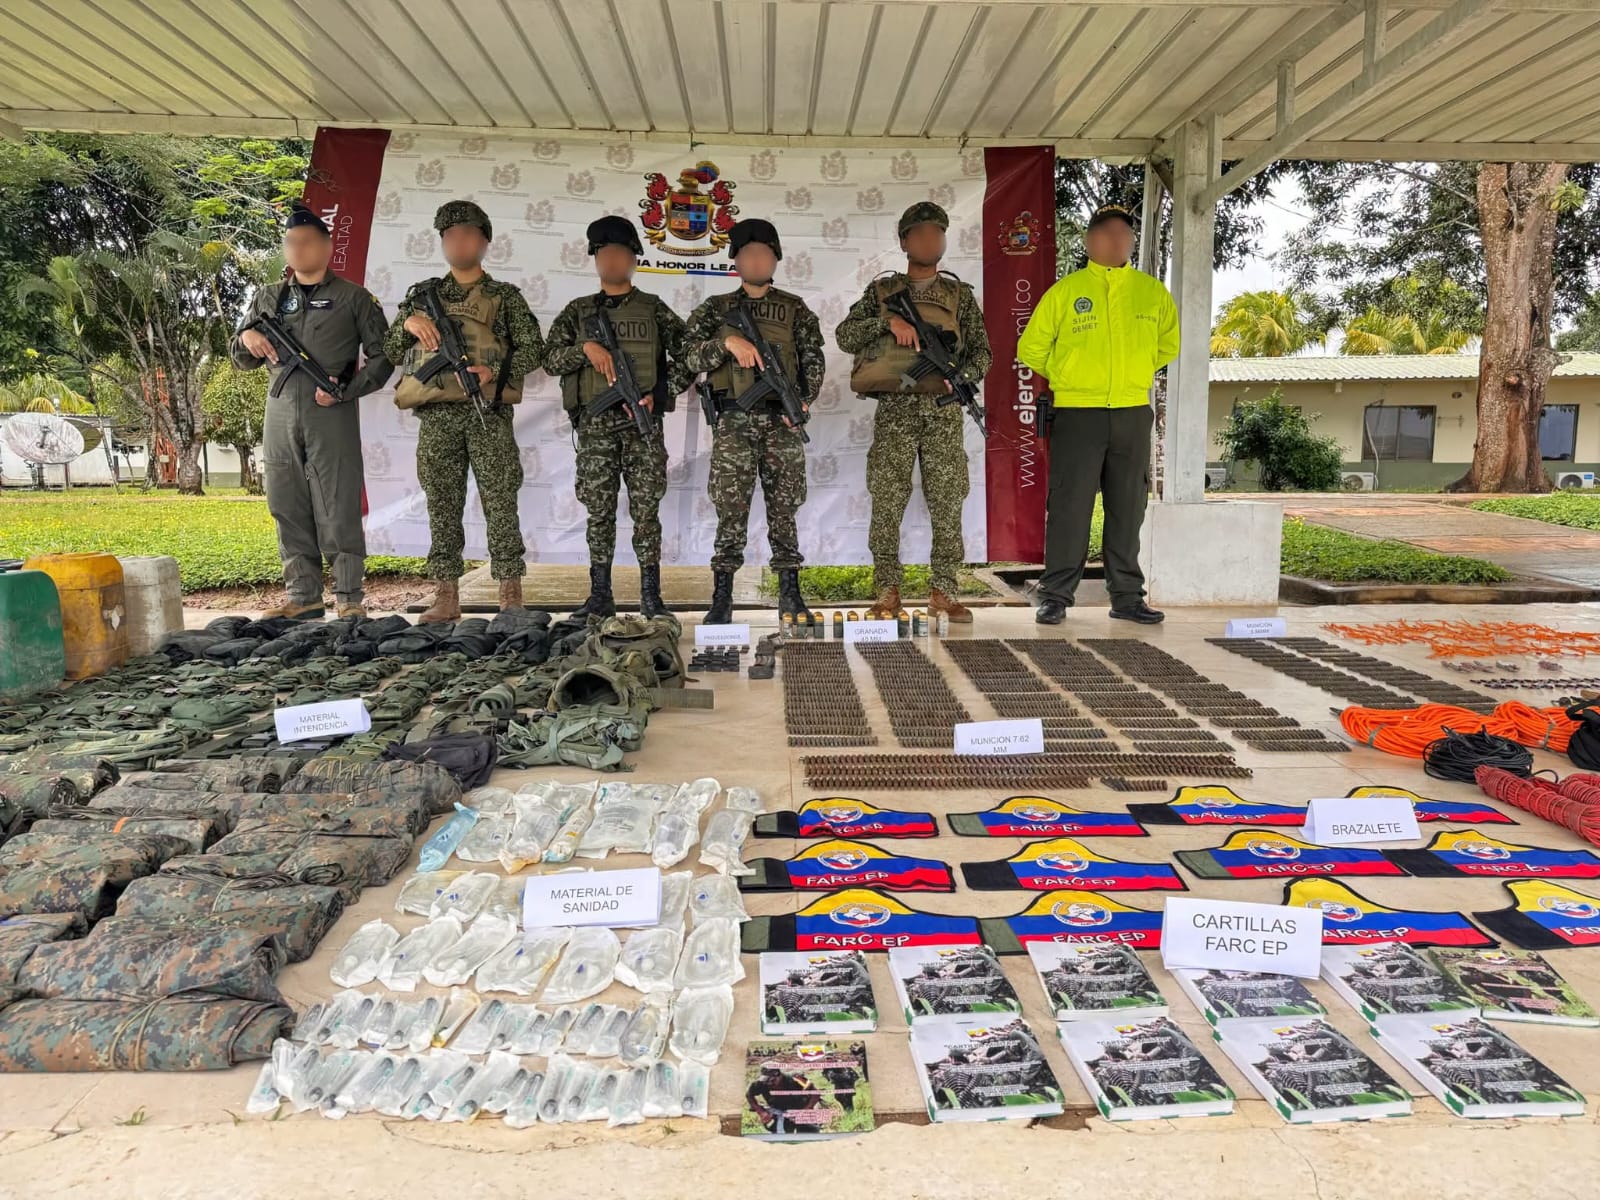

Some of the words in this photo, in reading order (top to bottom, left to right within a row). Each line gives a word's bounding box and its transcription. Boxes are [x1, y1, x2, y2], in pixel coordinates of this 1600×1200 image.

[331, 215, 353, 272] LEALTAD
[636, 259, 651, 267] IA
[655, 260, 706, 271] HONOR
[710, 263, 738, 272] LEA
[854, 627, 889, 636] GRANADA
[299, 711, 341, 724] MATERIAL
[293, 720, 349, 734] INTENDENCIA
[970, 735, 1011, 745] MUNICION
[1012, 734, 1030, 744] 7.62
[993, 745, 1008, 754] MM
[1331, 822, 1403, 836] BRAZALETE
[550, 886, 613, 899] MATERIAL
[616, 885, 633, 896] DE
[562, 900, 620, 914] SANIDAD
[1192, 913, 1297, 935] CARTILLAS
[1322, 927, 1411, 939] ARC-EP
[1205, 936, 1256, 954] FARC
[1262, 940, 1288, 956] EP
